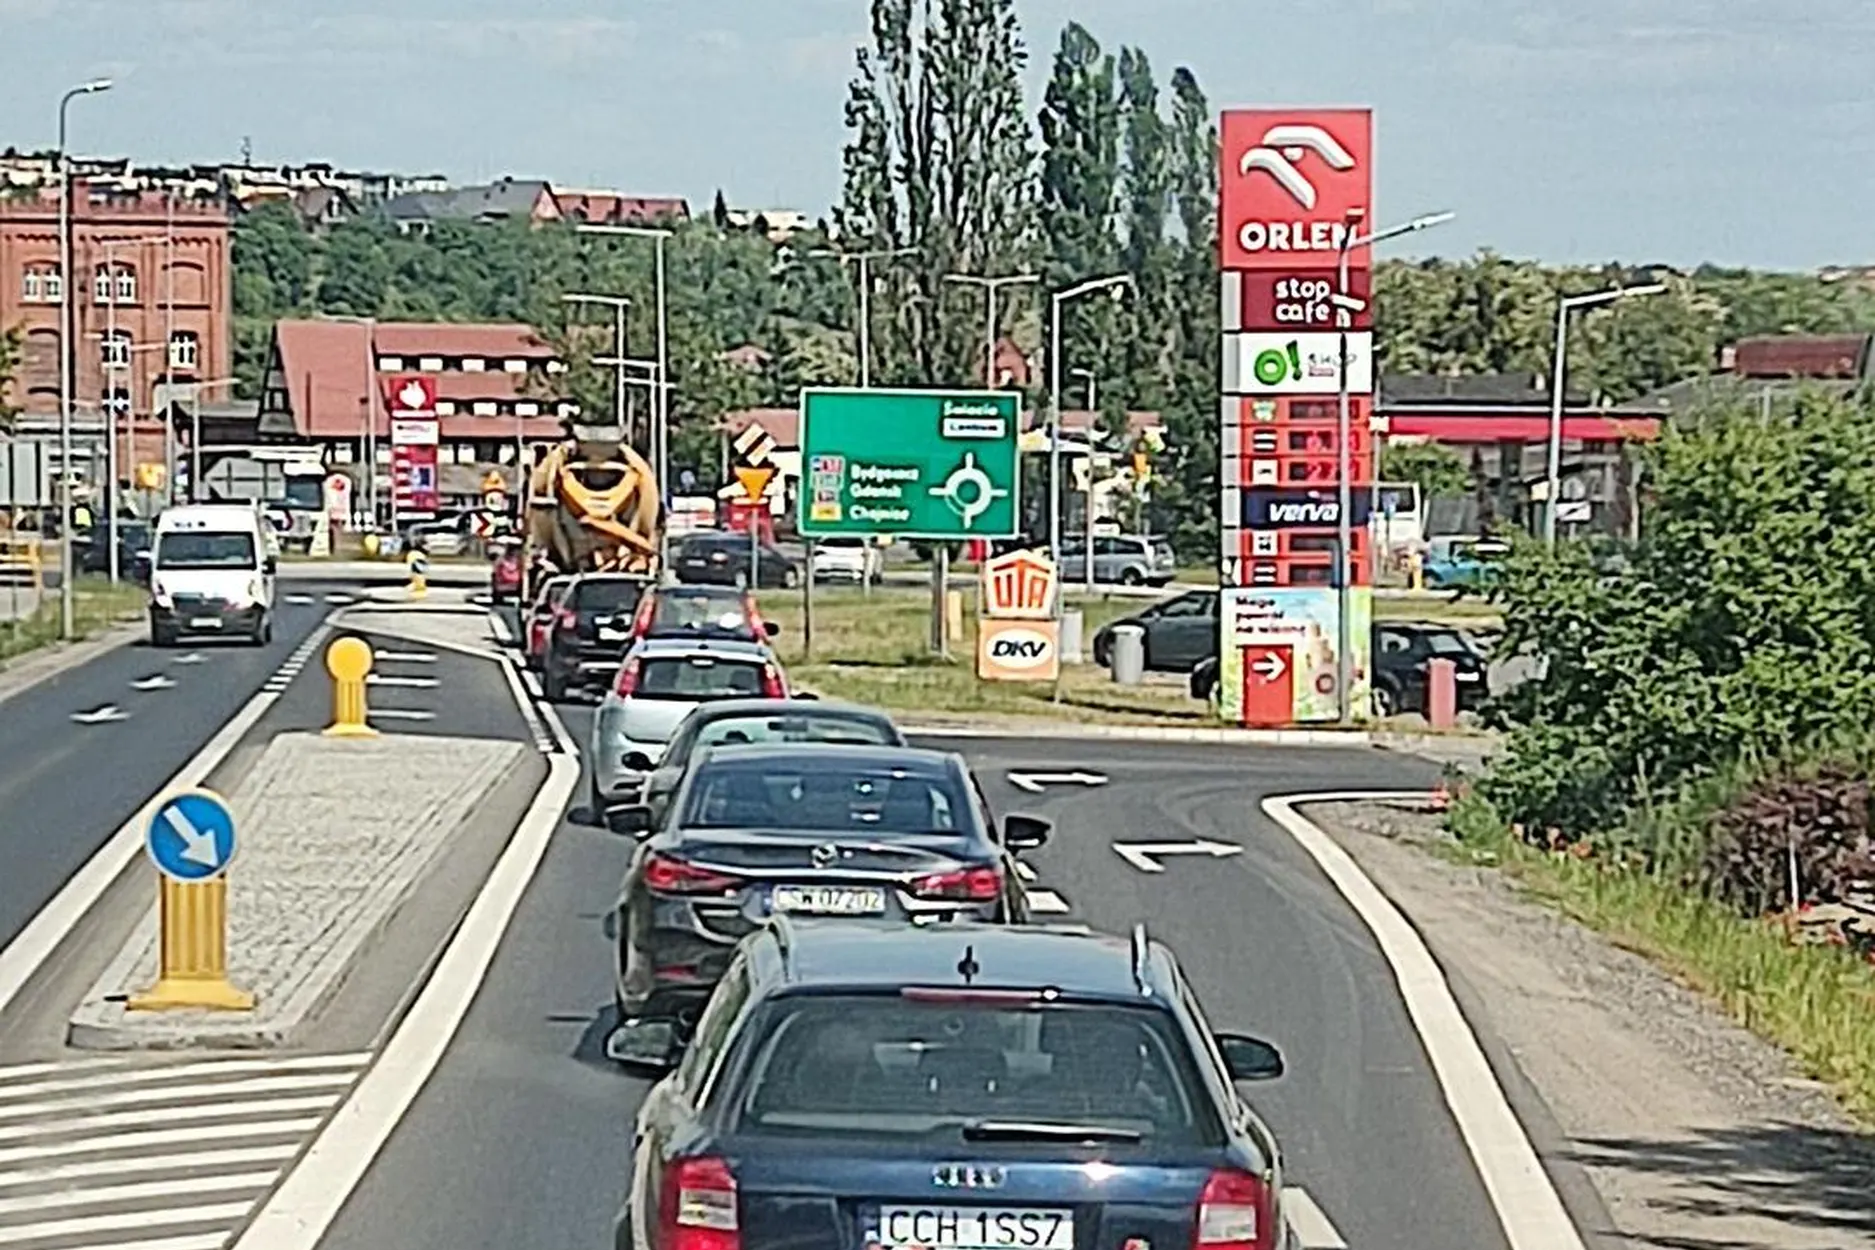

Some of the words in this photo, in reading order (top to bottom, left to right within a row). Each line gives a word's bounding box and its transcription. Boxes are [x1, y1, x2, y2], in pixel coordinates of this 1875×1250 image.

[1240, 222, 1358, 251] ORLEN
[1275, 278, 1331, 302] stop
[1275, 301, 1331, 323] cafe
[1270, 503, 1339, 522] verva
[993, 558, 1050, 609] UTA
[992, 640, 1046, 658] DKV
[889, 1210, 958, 1244] CCH
[976, 1212, 1063, 1247] 1SS7
